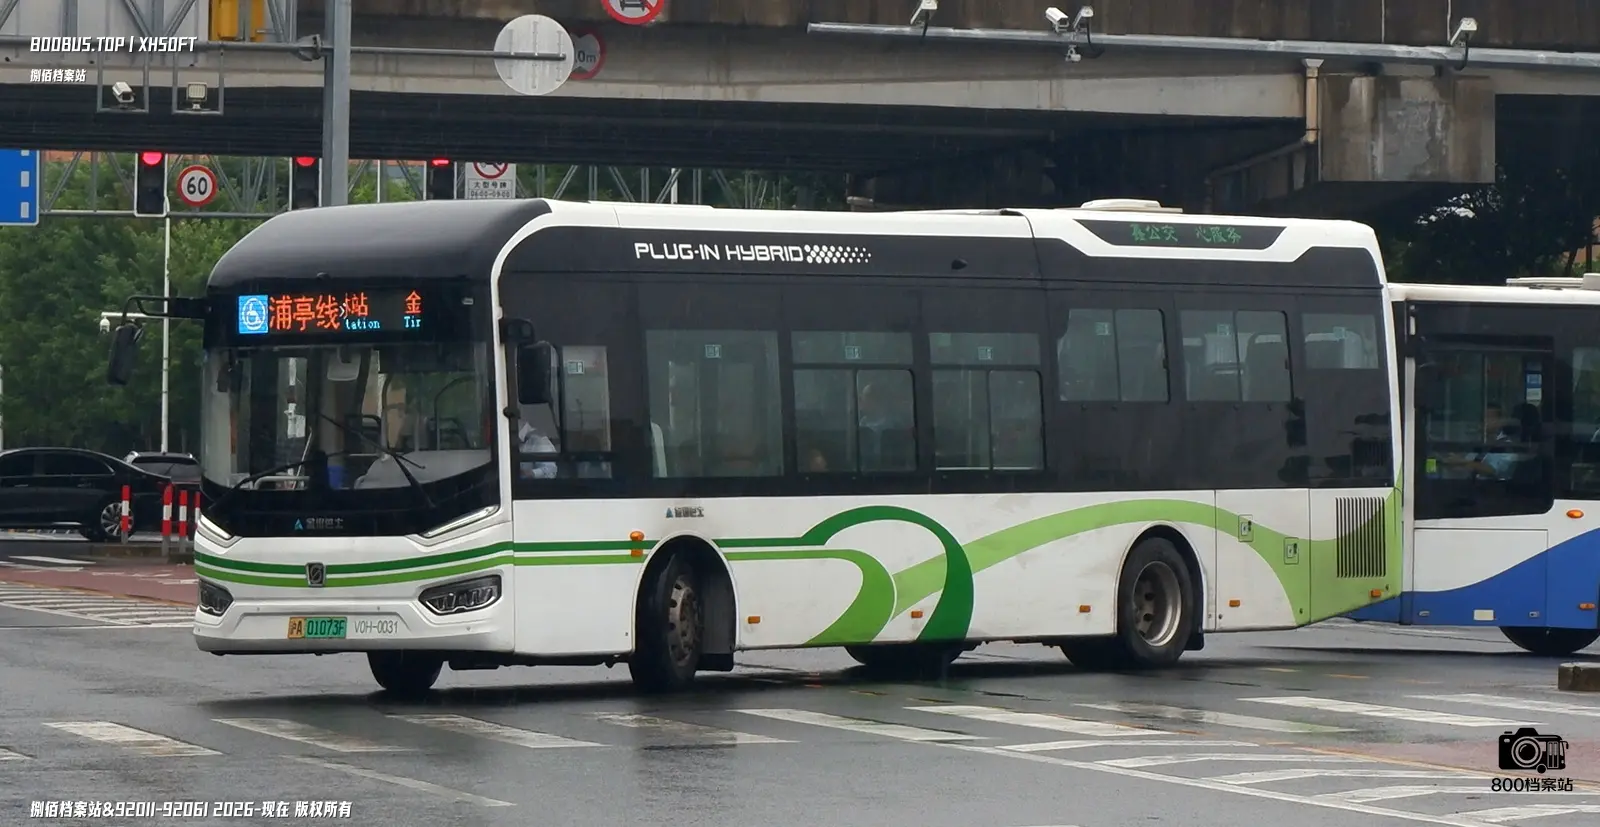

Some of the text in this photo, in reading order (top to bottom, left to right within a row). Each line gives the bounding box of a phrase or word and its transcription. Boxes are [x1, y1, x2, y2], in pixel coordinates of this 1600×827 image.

[186, 176, 208, 195] 60
[634, 242, 804, 262] PLUG-IN HYBRID
[268, 294, 341, 331] 浦亭线
[404, 290, 422, 315] 金
